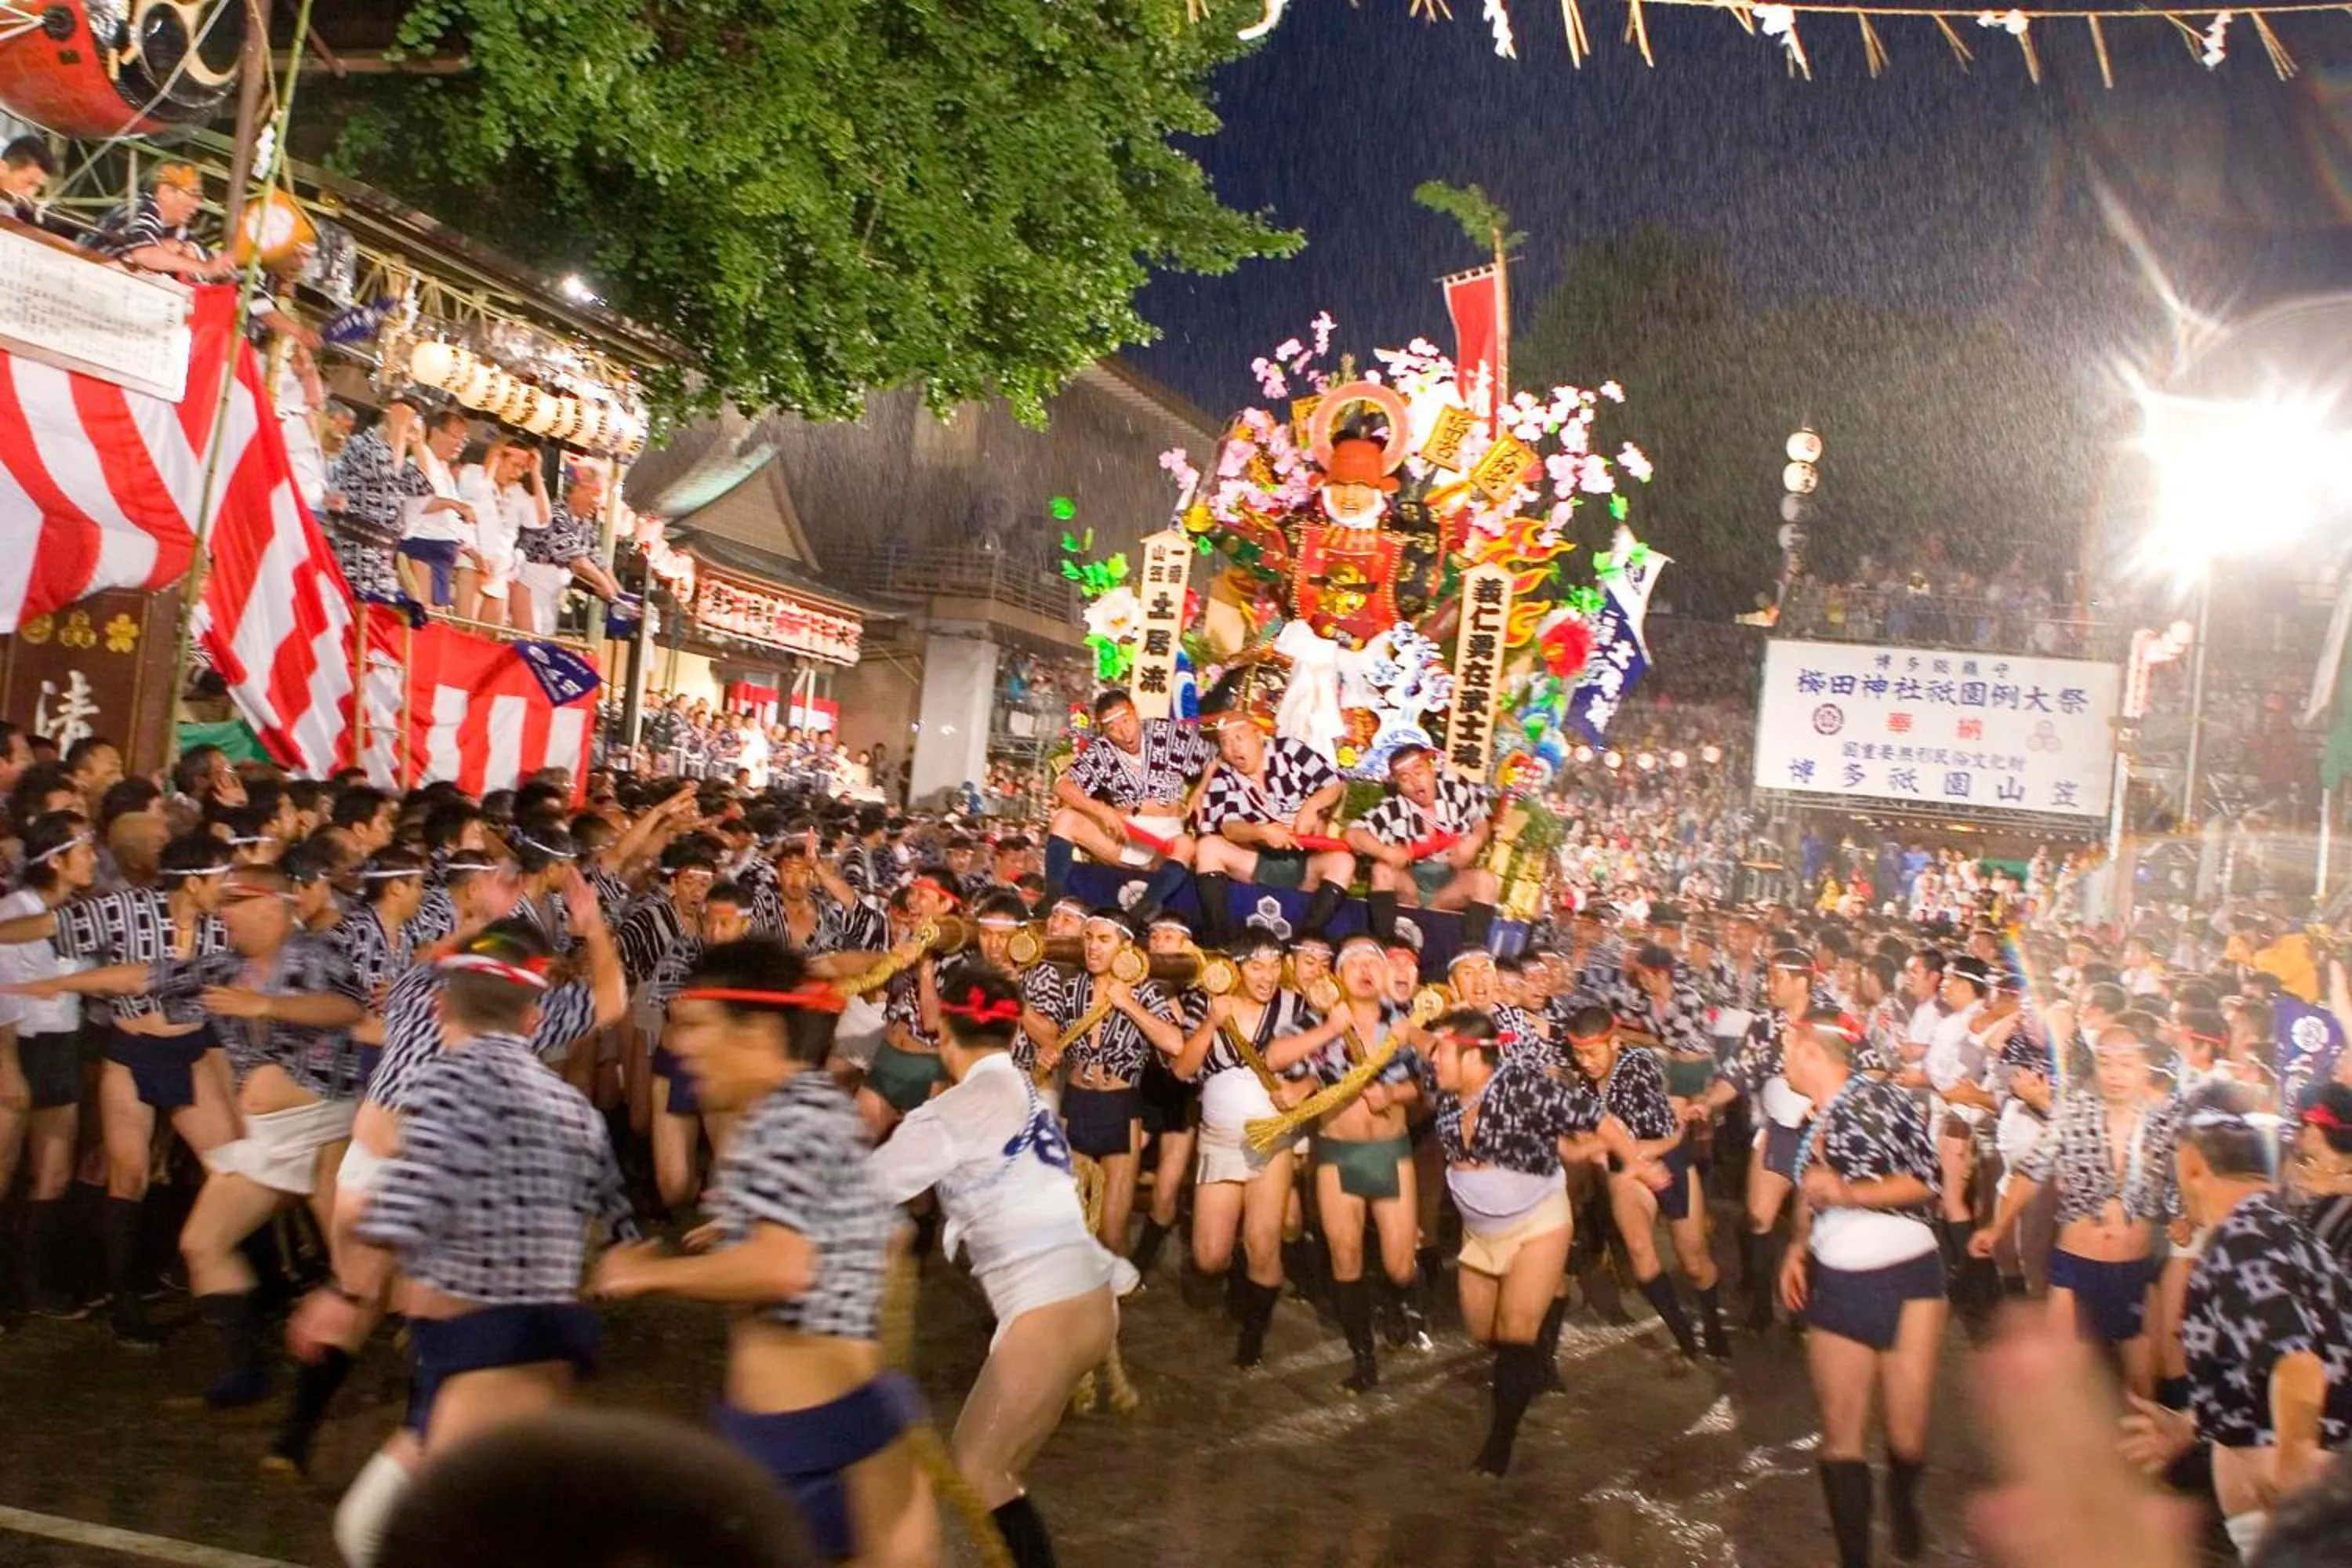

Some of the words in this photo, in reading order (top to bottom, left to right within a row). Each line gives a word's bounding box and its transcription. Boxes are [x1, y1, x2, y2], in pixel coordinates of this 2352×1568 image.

[1149, 545, 1166, 582] 山笠
[1168, 550, 1185, 583] 一番
[1139, 591, 1175, 694] 土居流
[1796, 668, 2089, 714] 櫛田神社祇園例大祭
[1887, 712, 1983, 741] 奉納
[1787, 758, 2080, 808] 博多祇園山笠
